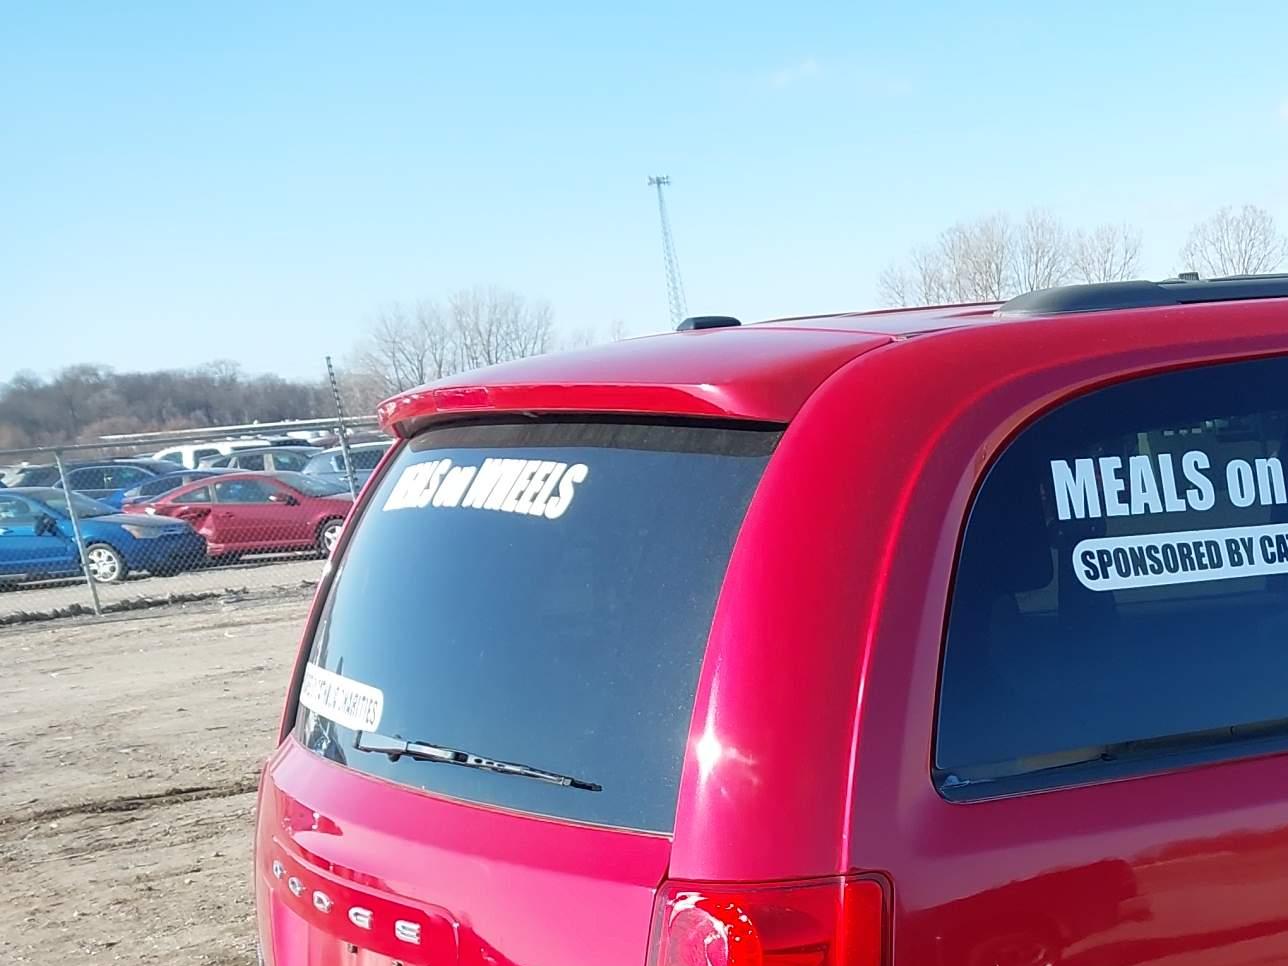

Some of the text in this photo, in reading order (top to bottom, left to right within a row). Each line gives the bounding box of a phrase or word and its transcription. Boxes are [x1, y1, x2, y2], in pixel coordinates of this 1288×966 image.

[461, 457, 589, 520] WHEELS
[1050, 450, 1216, 521] MEALS
[1225, 456, 1288, 508] on
[1079, 544, 1225, 581] SPONSORED
[1226, 538, 1258, 568] BY
